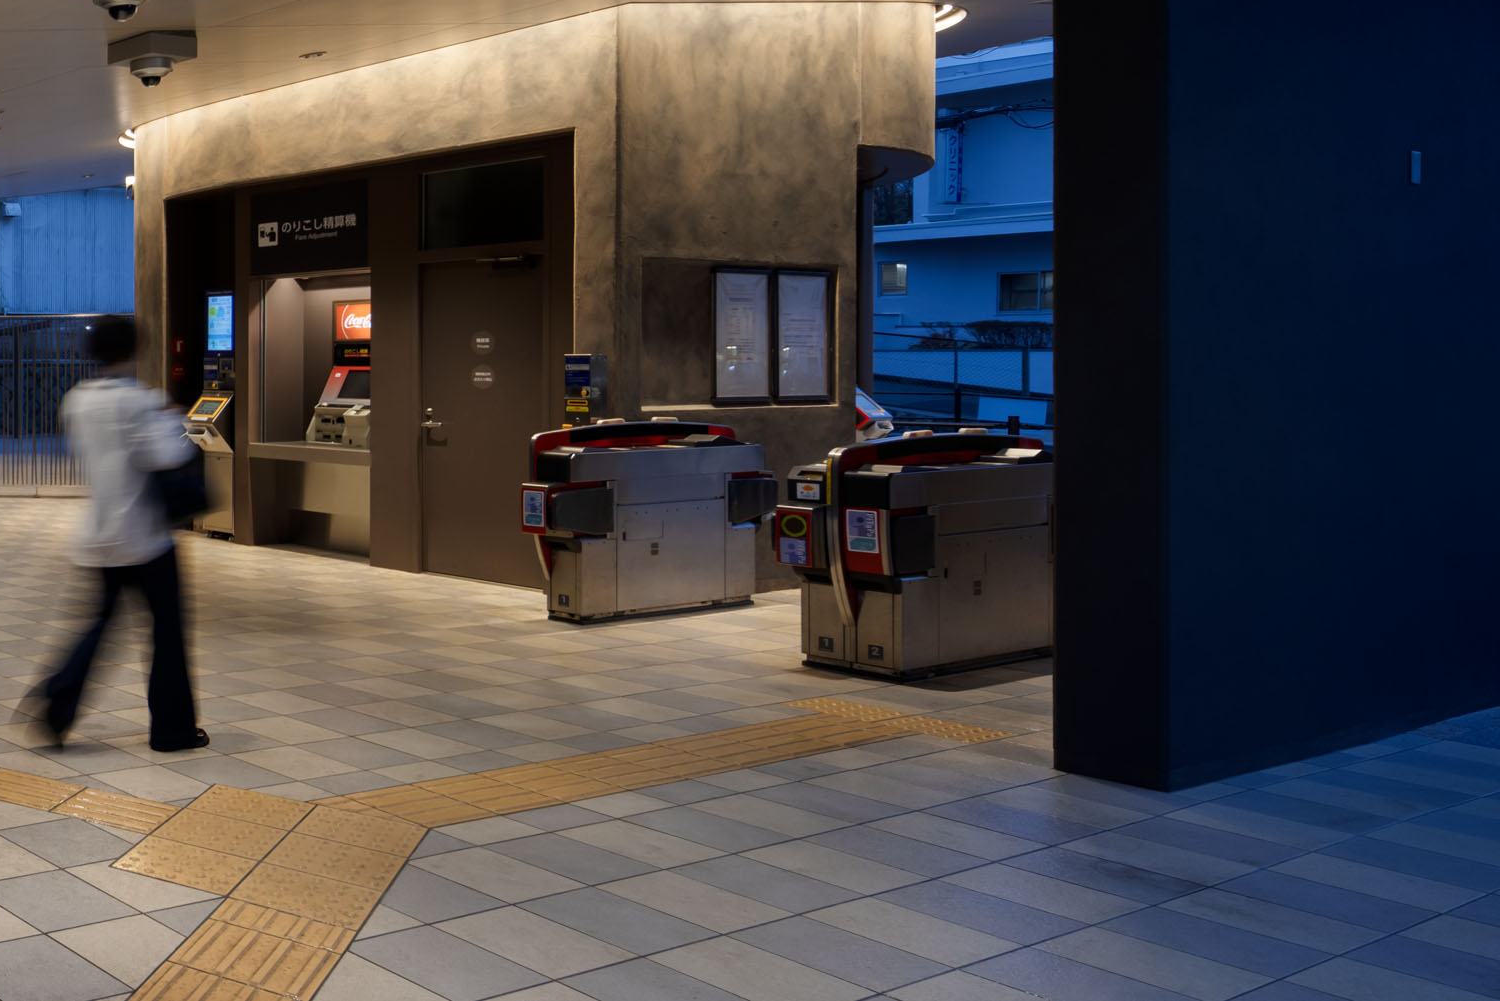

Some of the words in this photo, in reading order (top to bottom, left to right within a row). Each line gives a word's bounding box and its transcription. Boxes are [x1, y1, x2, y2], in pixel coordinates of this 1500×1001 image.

[948, 135, 957, 196] クリニック
[281, 213, 357, 233] のりこし精算機
[871, 647, 881, 657] 2
